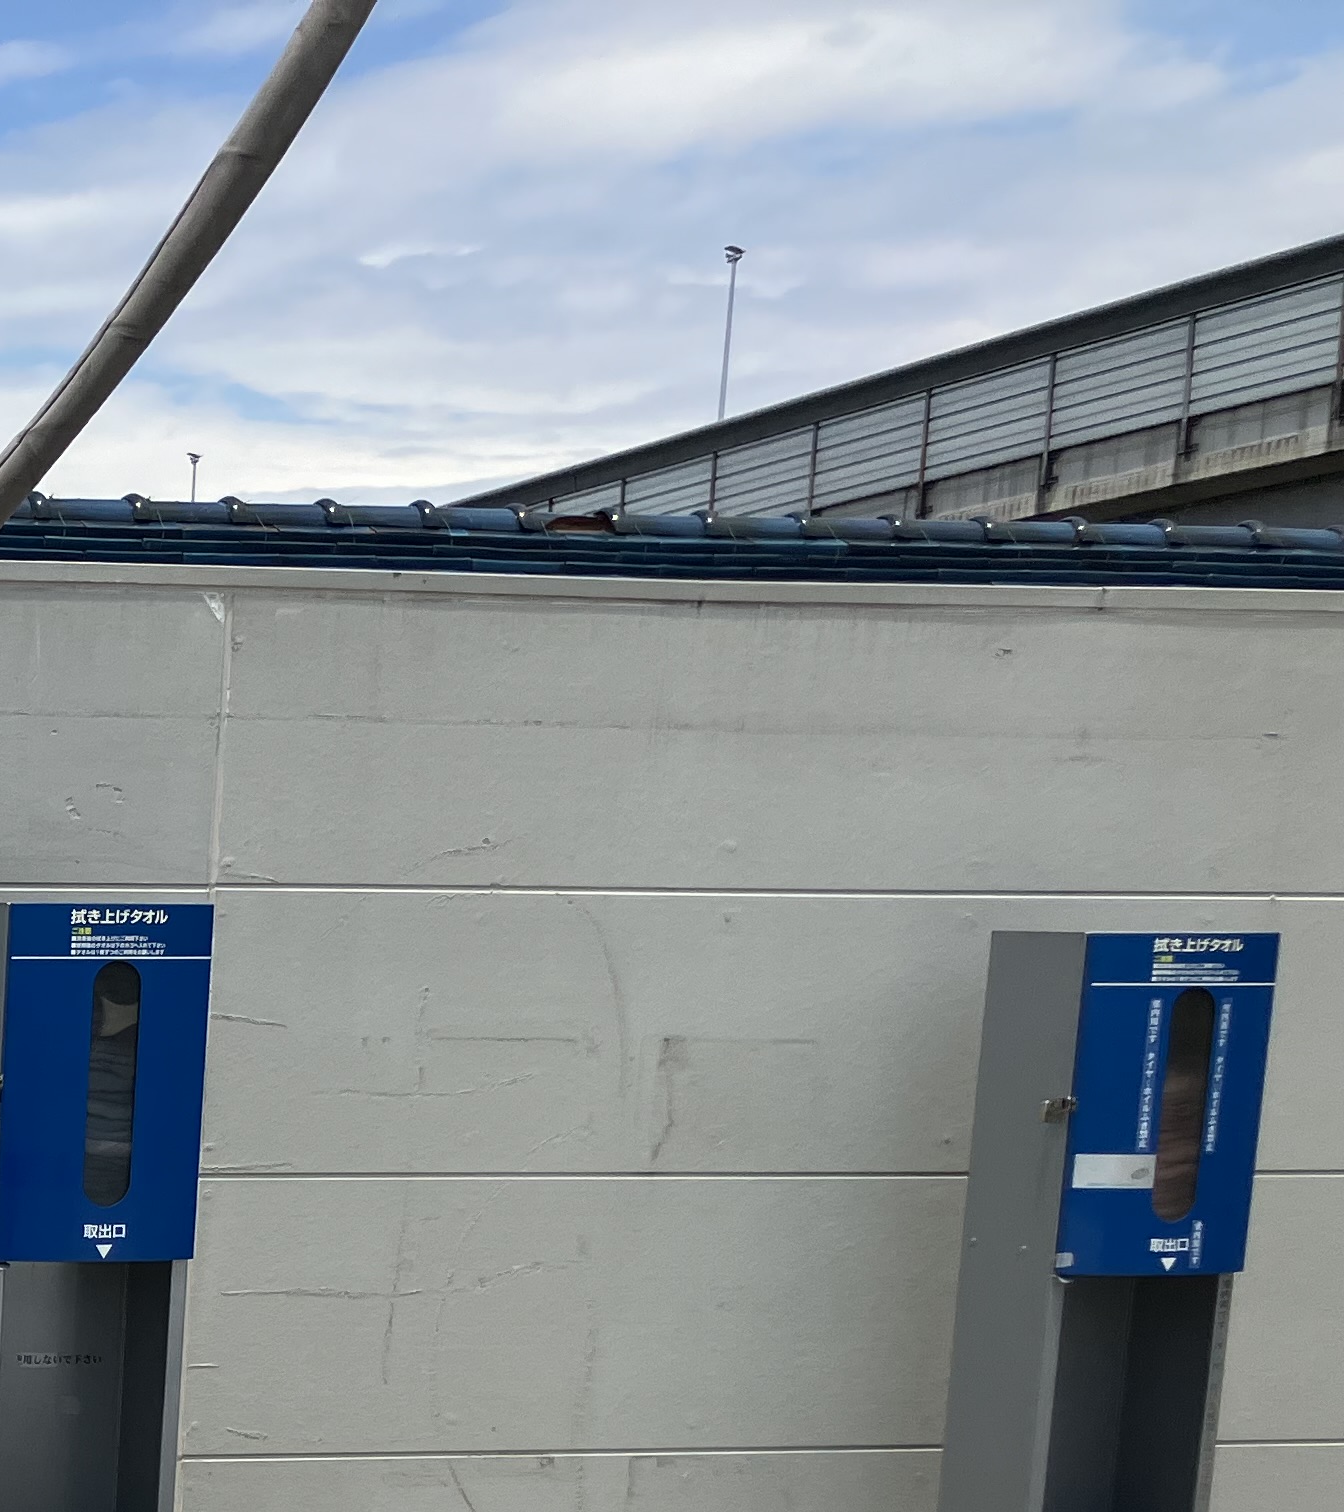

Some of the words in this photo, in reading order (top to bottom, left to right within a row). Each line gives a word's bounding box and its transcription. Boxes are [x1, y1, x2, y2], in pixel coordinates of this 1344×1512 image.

[70, 908, 169, 924] 拭き上げタオル
[83, 1224, 126, 1239] 取出口
[1150, 1238, 1189, 1253] 取出口
